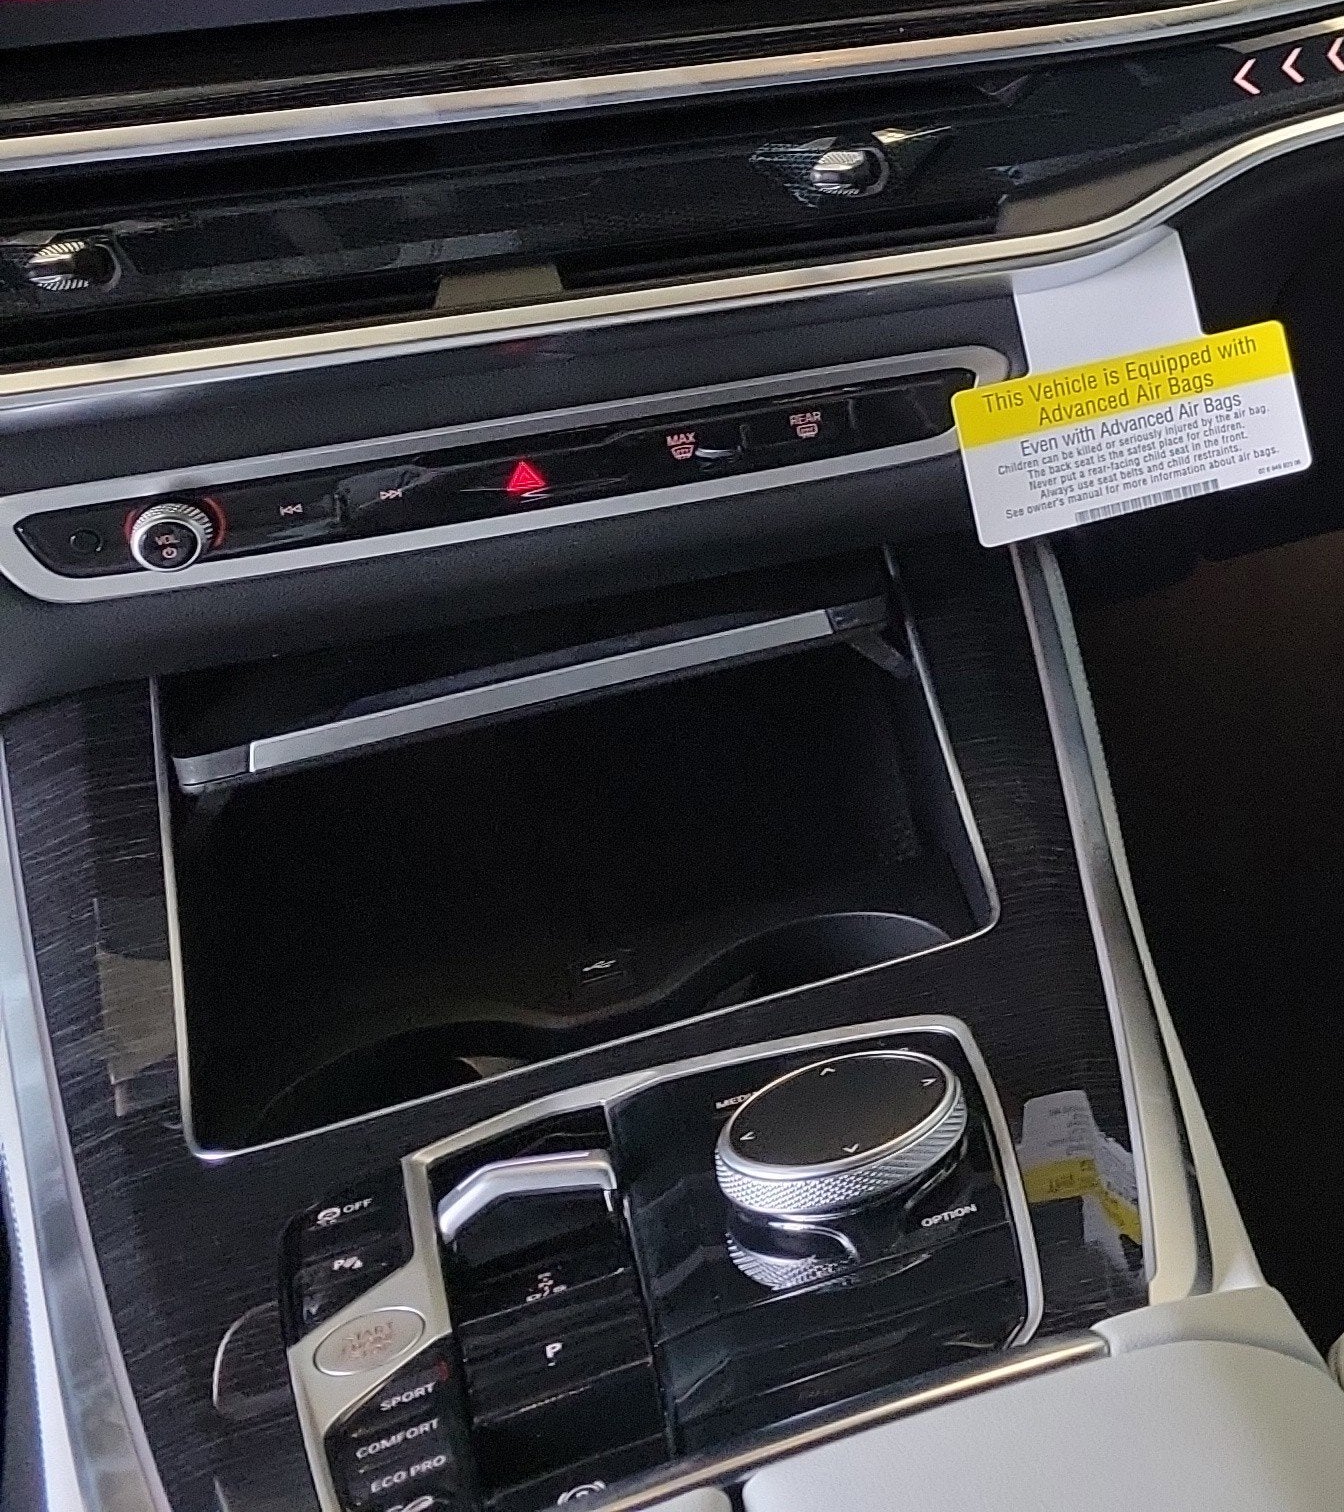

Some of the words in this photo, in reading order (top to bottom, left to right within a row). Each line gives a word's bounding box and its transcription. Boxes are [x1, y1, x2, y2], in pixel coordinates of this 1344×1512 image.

[982, 390, 1024, 413] This
[1028, 373, 1098, 402] Vehicle
[1103, 368, 1120, 386] is
[1125, 344, 1211, 380] Equipped
[1217, 336, 1257, 359] with
[789, 411, 822, 426] REAR
[1039, 388, 1130, 426] Advanced
[1137, 382, 1162, 403] Air
[1167, 373, 1214, 395] Bags
[666, 431, 696, 447] MAX
[998, 458, 1039, 475] Children
[1042, 454, 1059, 465] can
[1061, 450, 1074, 460] be
[1077, 442, 1102, 456] killed
[1105, 440, 1116, 449] or
[1119, 429, 1162, 446] seriously
[1165, 420, 1198, 434] injured
[1201, 417, 1212, 427] by
[1215, 413, 1231, 423] the
[1234, 409, 1246, 419] air
[1249, 405, 1270, 415] bag.
[1020, 437, 1058, 457] Even
[1062, 426, 1096, 446] with
[1100, 406, 1174, 438] Advanced
[1179, 402, 1199, 420] Air
[1203, 394, 1242, 413] Bags
[1027, 469, 1046, 479] The
[1049, 461, 1072, 474] back
[1074, 456, 1095, 468] seat
[1098, 453, 1106, 462] is
[1109, 450, 1124, 460] the
[1127, 441, 1156, 455] safest
[1159, 436, 1184, 449] place
[1187, 432, 1200, 441] for
[1203, 422, 1245, 437] children.
[1029, 477, 1057, 490] Never
[1060, 472, 1077, 484] put
[1079, 470, 1086, 478] a
[1088, 456, 1140, 476] rear-facing
[1143, 450, 1166, 463] child
[1169, 444, 1190, 456] seat
[1192, 442, 1201, 451] in
[1204, 439, 1219, 448] the
[1222, 431, 1248, 444] front.
[1040, 485, 1074, 499] Always
[1077, 480, 1094, 490] use
[1097, 473, 1118, 485] seat
[1120, 468, 1144, 480] belts
[1147, 462, 1164, 473] and
[1167, 455, 1190, 468] child
[1193, 444, 1242, 462] restraints.
[1005, 508, 1024, 519] See
[1027, 498, 1065, 514] owner's
[1067, 488, 1103, 504] manual
[1105, 484, 1119, 494] for
[1122, 478, 1148, 490] more
[1150, 462, 1206, 483] information
[1209, 455, 1236, 469] about
[1238, 452, 1251, 462] air
[1253, 447, 1279, 459] bags.
[715, 1092, 758, 1109] MED
[343, 1198, 373, 1213] OFF
[921, 1203, 978, 1227] OPTION
[545, 1342, 563, 1359] P
[380, 1381, 437, 1411] SPORT
[355, 1417, 439, 1459] COMFORT
[370, 1470, 408, 1494] ECO
[410, 1454, 447, 1477] PRO
